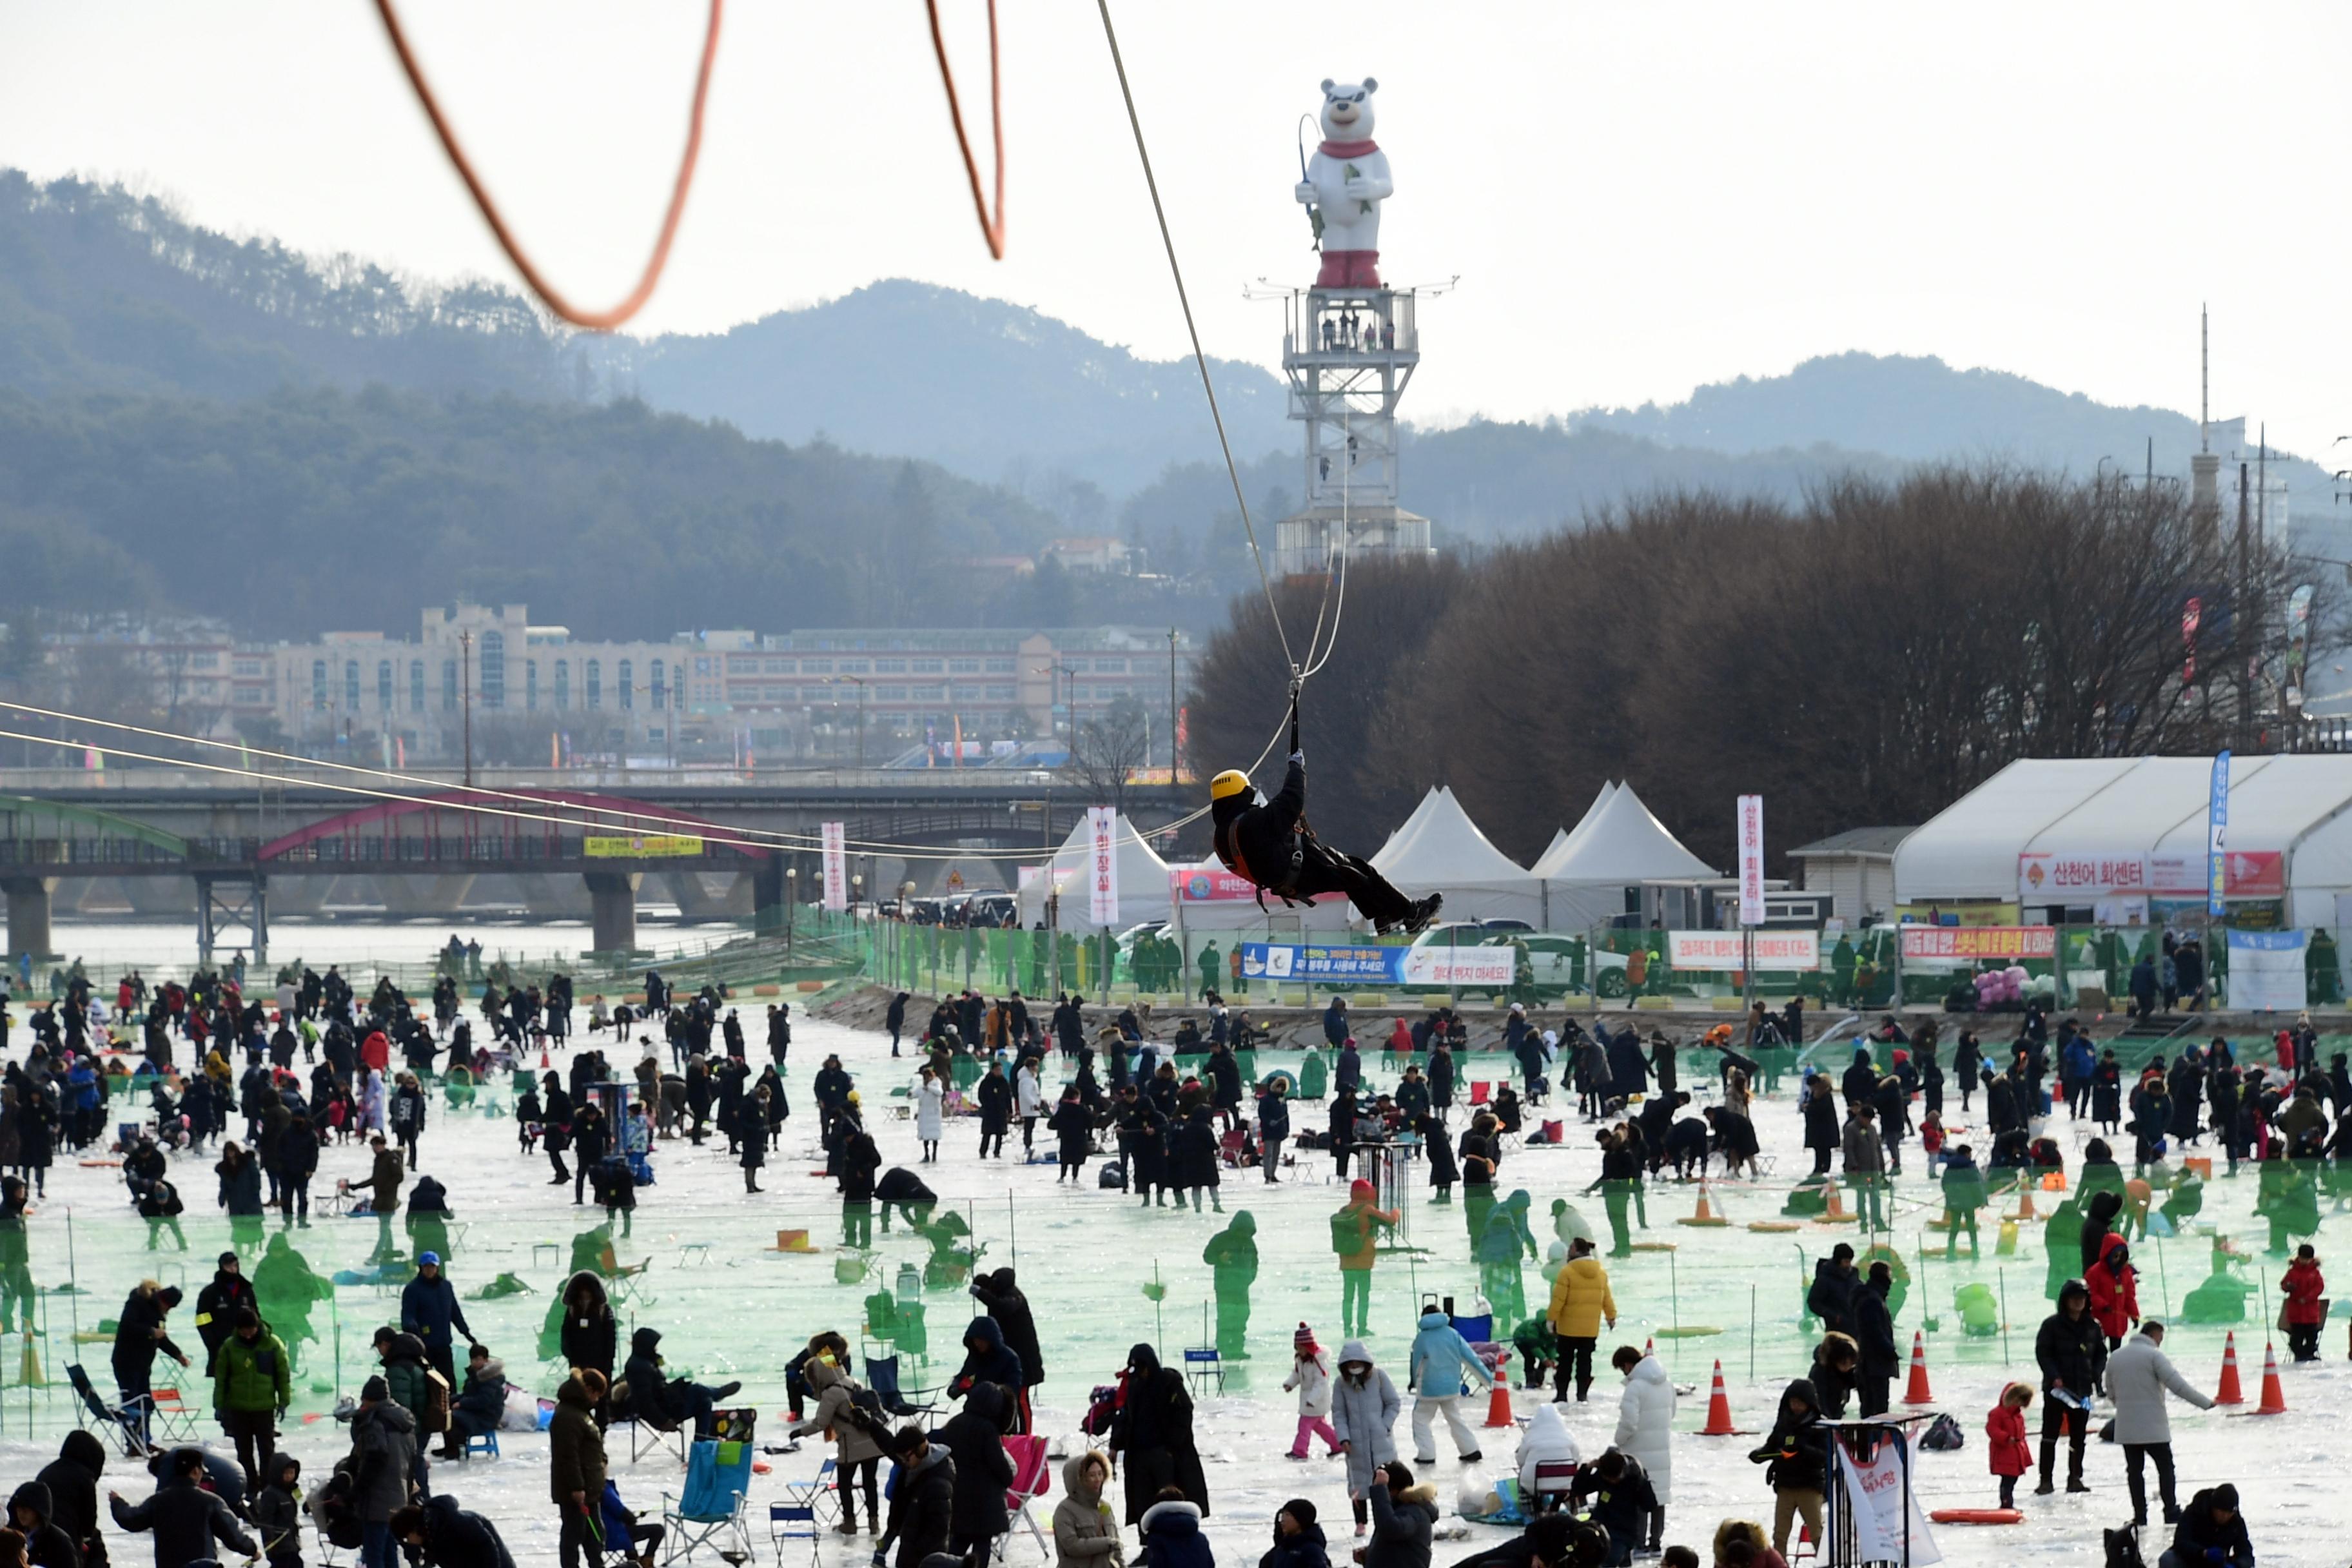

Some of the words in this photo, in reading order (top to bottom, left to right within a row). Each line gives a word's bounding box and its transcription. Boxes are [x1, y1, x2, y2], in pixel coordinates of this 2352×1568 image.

[1745, 805, 1758, 850] 산천어
[2216, 828, 2224, 848] 4
[1096, 834, 1110, 892] 화장실
[2053, 862, 2096, 886] 산천어
[2101, 861, 2144, 886] 회센터
[1218, 878, 1250, 892] 화천군
[1745, 857, 1759, 901] 회센터
[1308, 959, 1331, 972] 봉투를
[1333, 960, 1357, 972] 사용해
[1358, 961, 1386, 972] 주세요!
[1433, 965, 1451, 981] 절대
[1475, 965, 1509, 980] 마세요!
